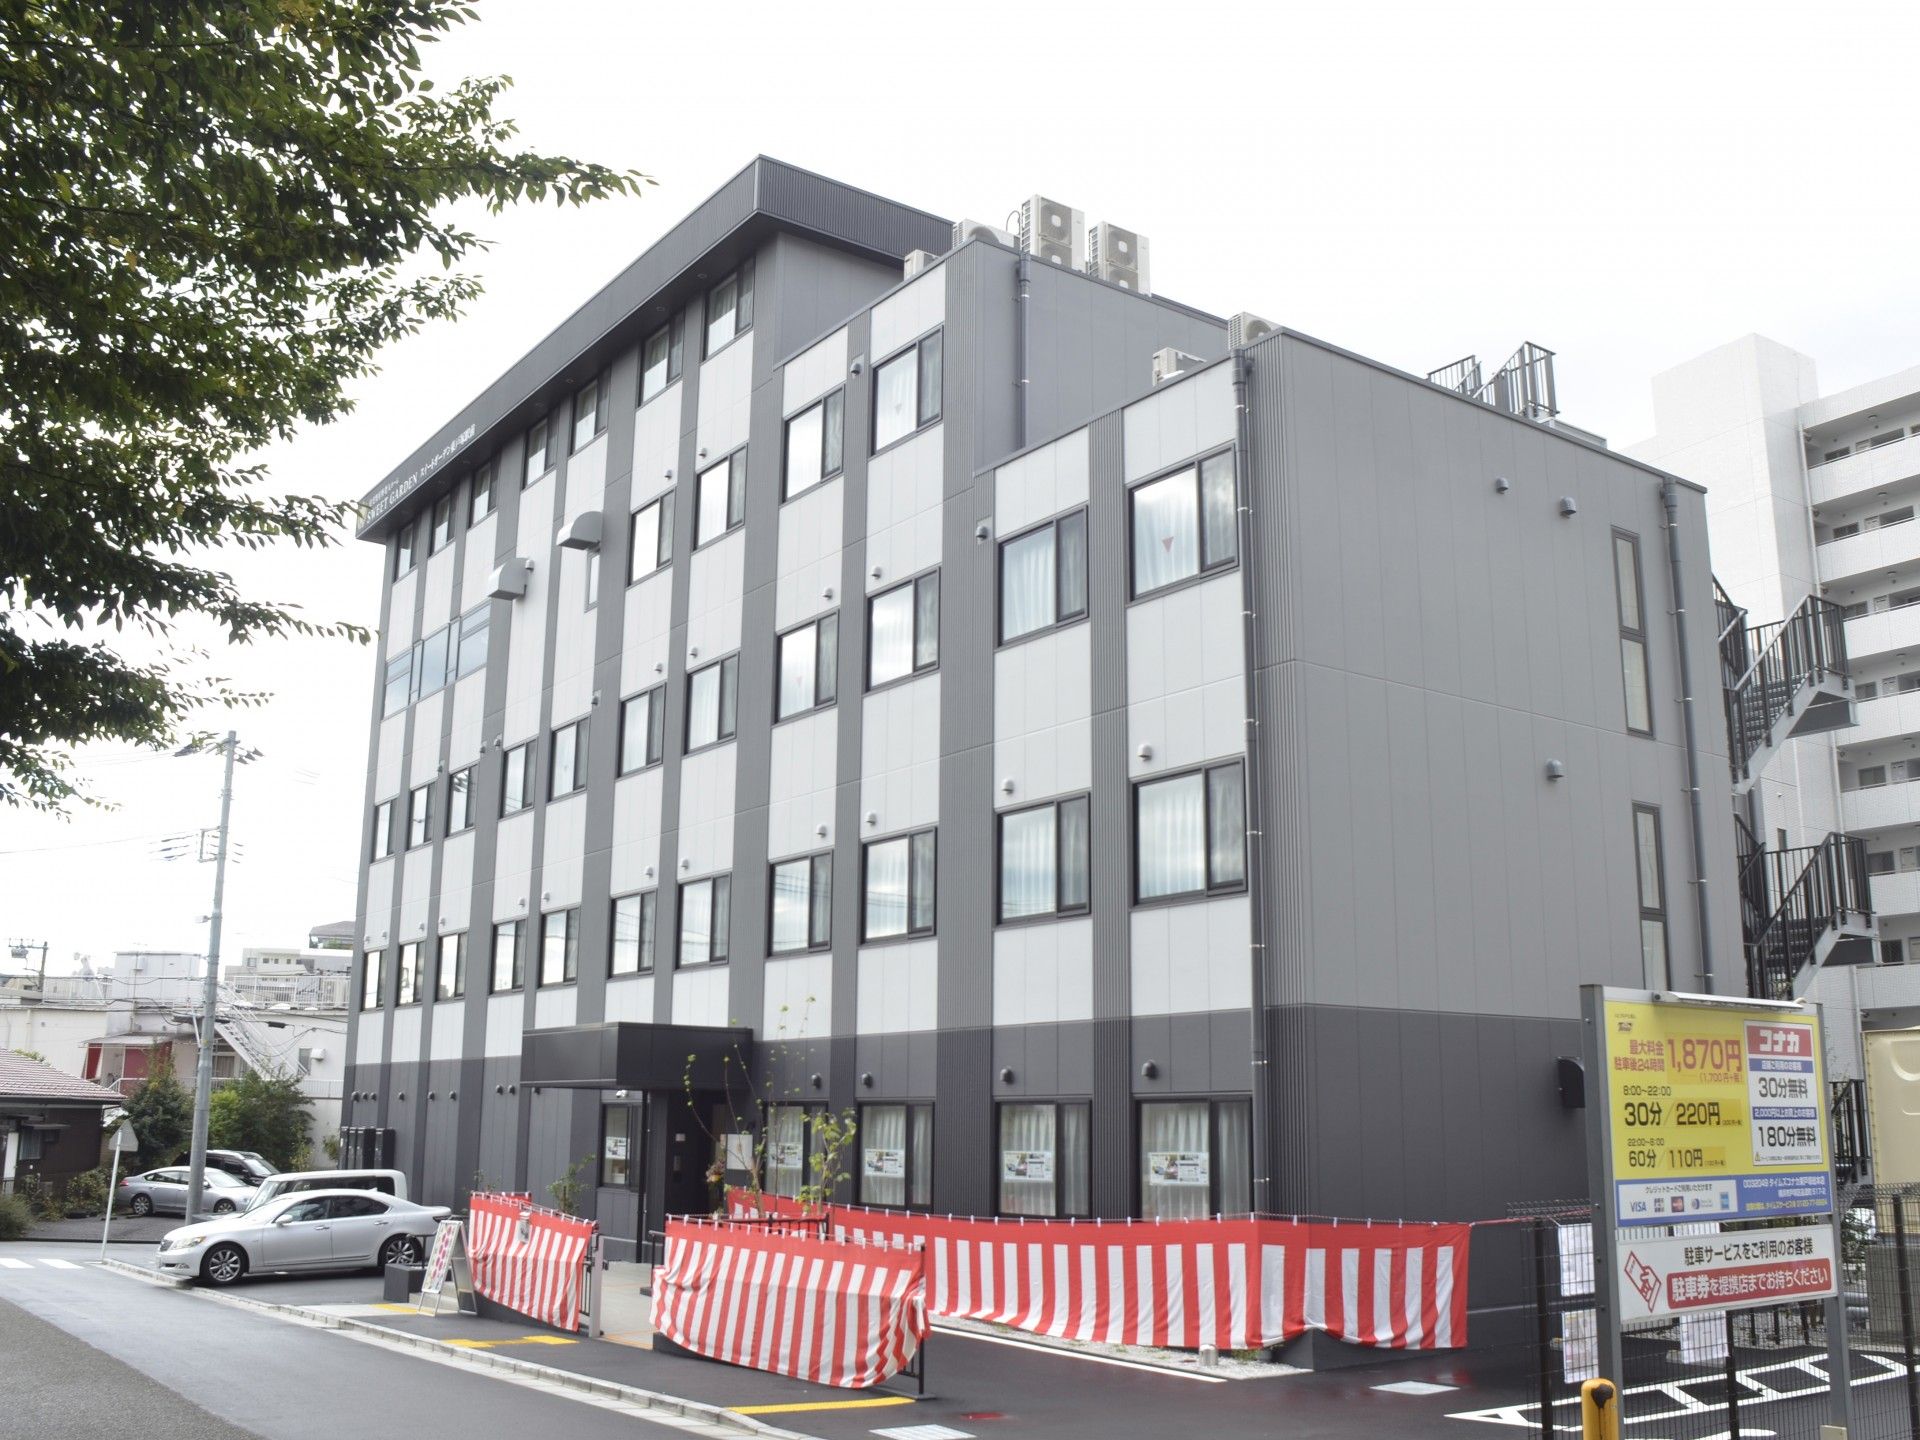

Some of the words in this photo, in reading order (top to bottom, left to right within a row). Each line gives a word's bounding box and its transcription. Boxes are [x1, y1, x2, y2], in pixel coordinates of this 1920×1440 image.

[389, 471, 418, 504] GARDEN
[1629, 1039, 1664, 1056] 最大料金
[1759, 1029, 1800, 1053] コナカ
[1614, 1056, 1665, 1072] 駐車後24時間
[1667, 1038, 1742, 1072] 1,870円
[1758, 1077, 1808, 1099] 30分無料
[1624, 1101, 1662, 1126] 30分
[1676, 1101, 1720, 1126] 220円
[1758, 1126, 1816, 1147] 180分無料
[1629, 1148, 1656, 1168] 60分
[1669, 1148, 1703, 1168] 110円
[1630, 1201, 1647, 1212] VISA
[1684, 1237, 1814, 1266] 駐車サービスをご利用のお客様
[1671, 1267, 1829, 1302] 駐車券を提携店までお持ちください
